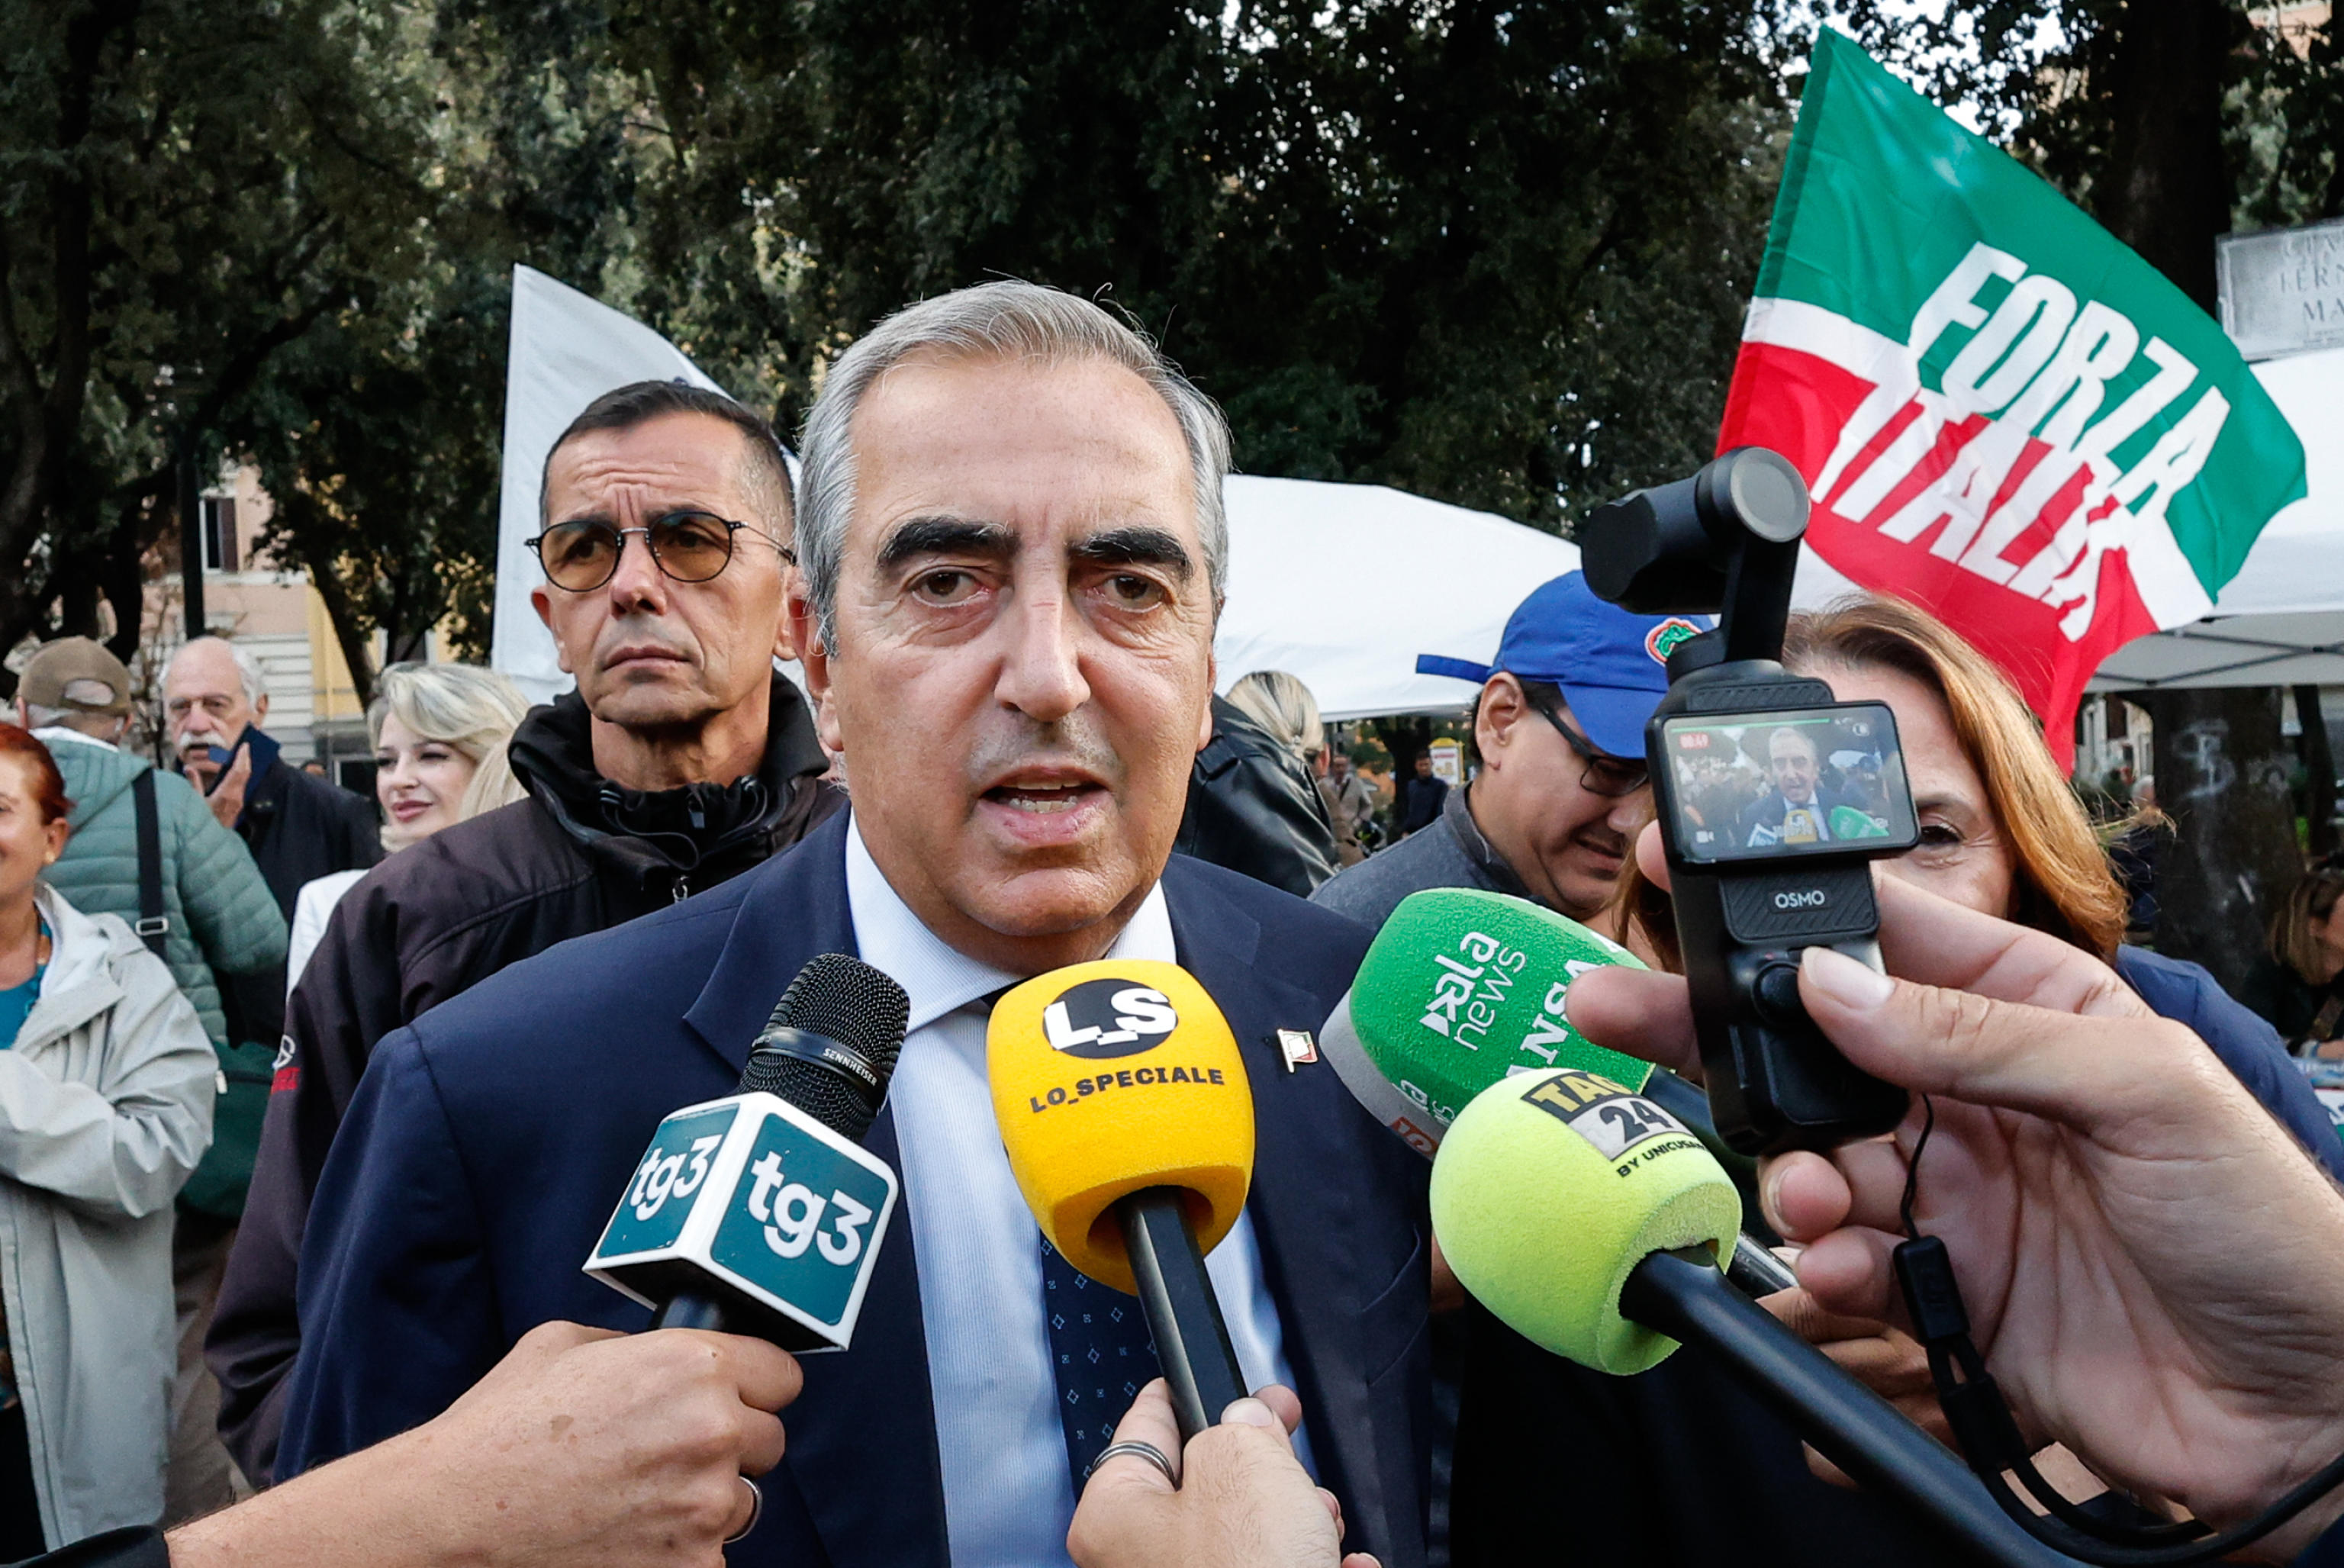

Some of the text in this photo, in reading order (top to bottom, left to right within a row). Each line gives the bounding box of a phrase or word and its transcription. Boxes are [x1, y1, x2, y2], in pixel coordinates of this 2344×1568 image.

[1908, 241, 2231, 516] FORZA
[1809, 378, 2130, 643] ITALIA
[1775, 890, 1826, 909] OSMO
[1454, 947, 1527, 1051] news
[823, 1048, 878, 1087] SENNHEISER
[1599, 1100, 1674, 1145] 24
[629, 1135, 873, 1267] tg3 tg3
[1616, 1157, 1640, 1178] BY
